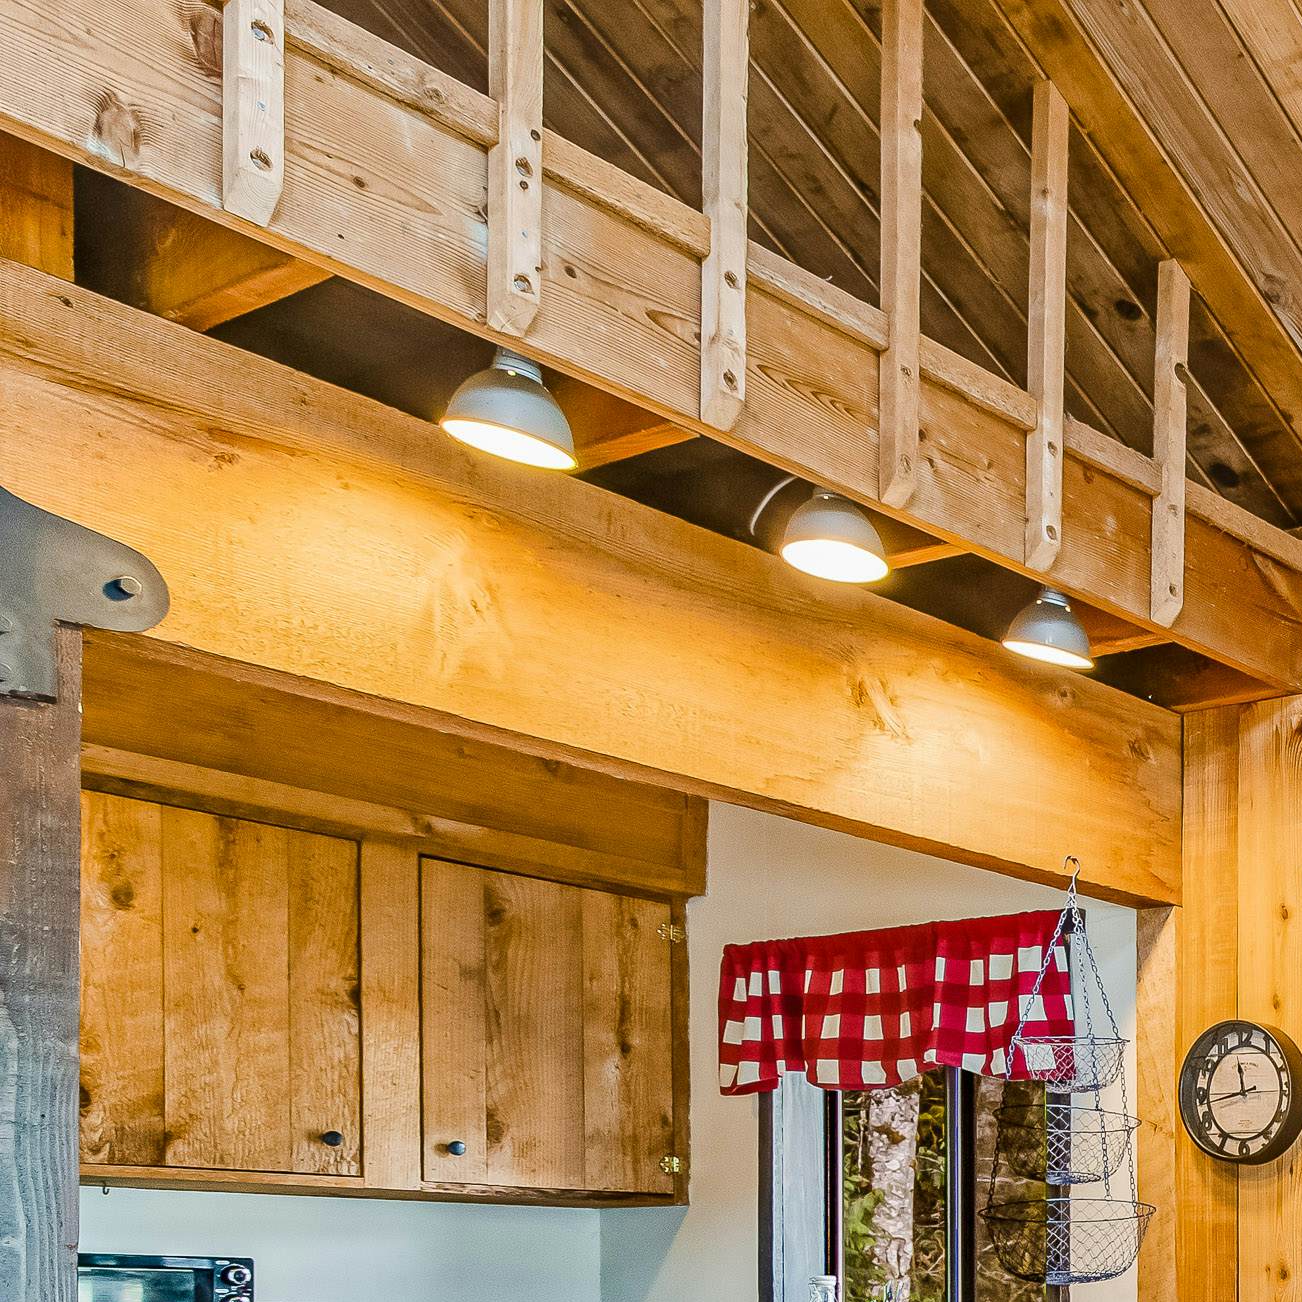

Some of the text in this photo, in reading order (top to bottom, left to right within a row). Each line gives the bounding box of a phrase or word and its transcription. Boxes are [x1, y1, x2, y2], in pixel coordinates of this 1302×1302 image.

[1237, 1031, 1253, 1046] 12
[1202, 1111, 1212, 1130] 8
[1217, 1132, 1229, 1151] 7
[1238, 1140, 1250, 1156] 6
